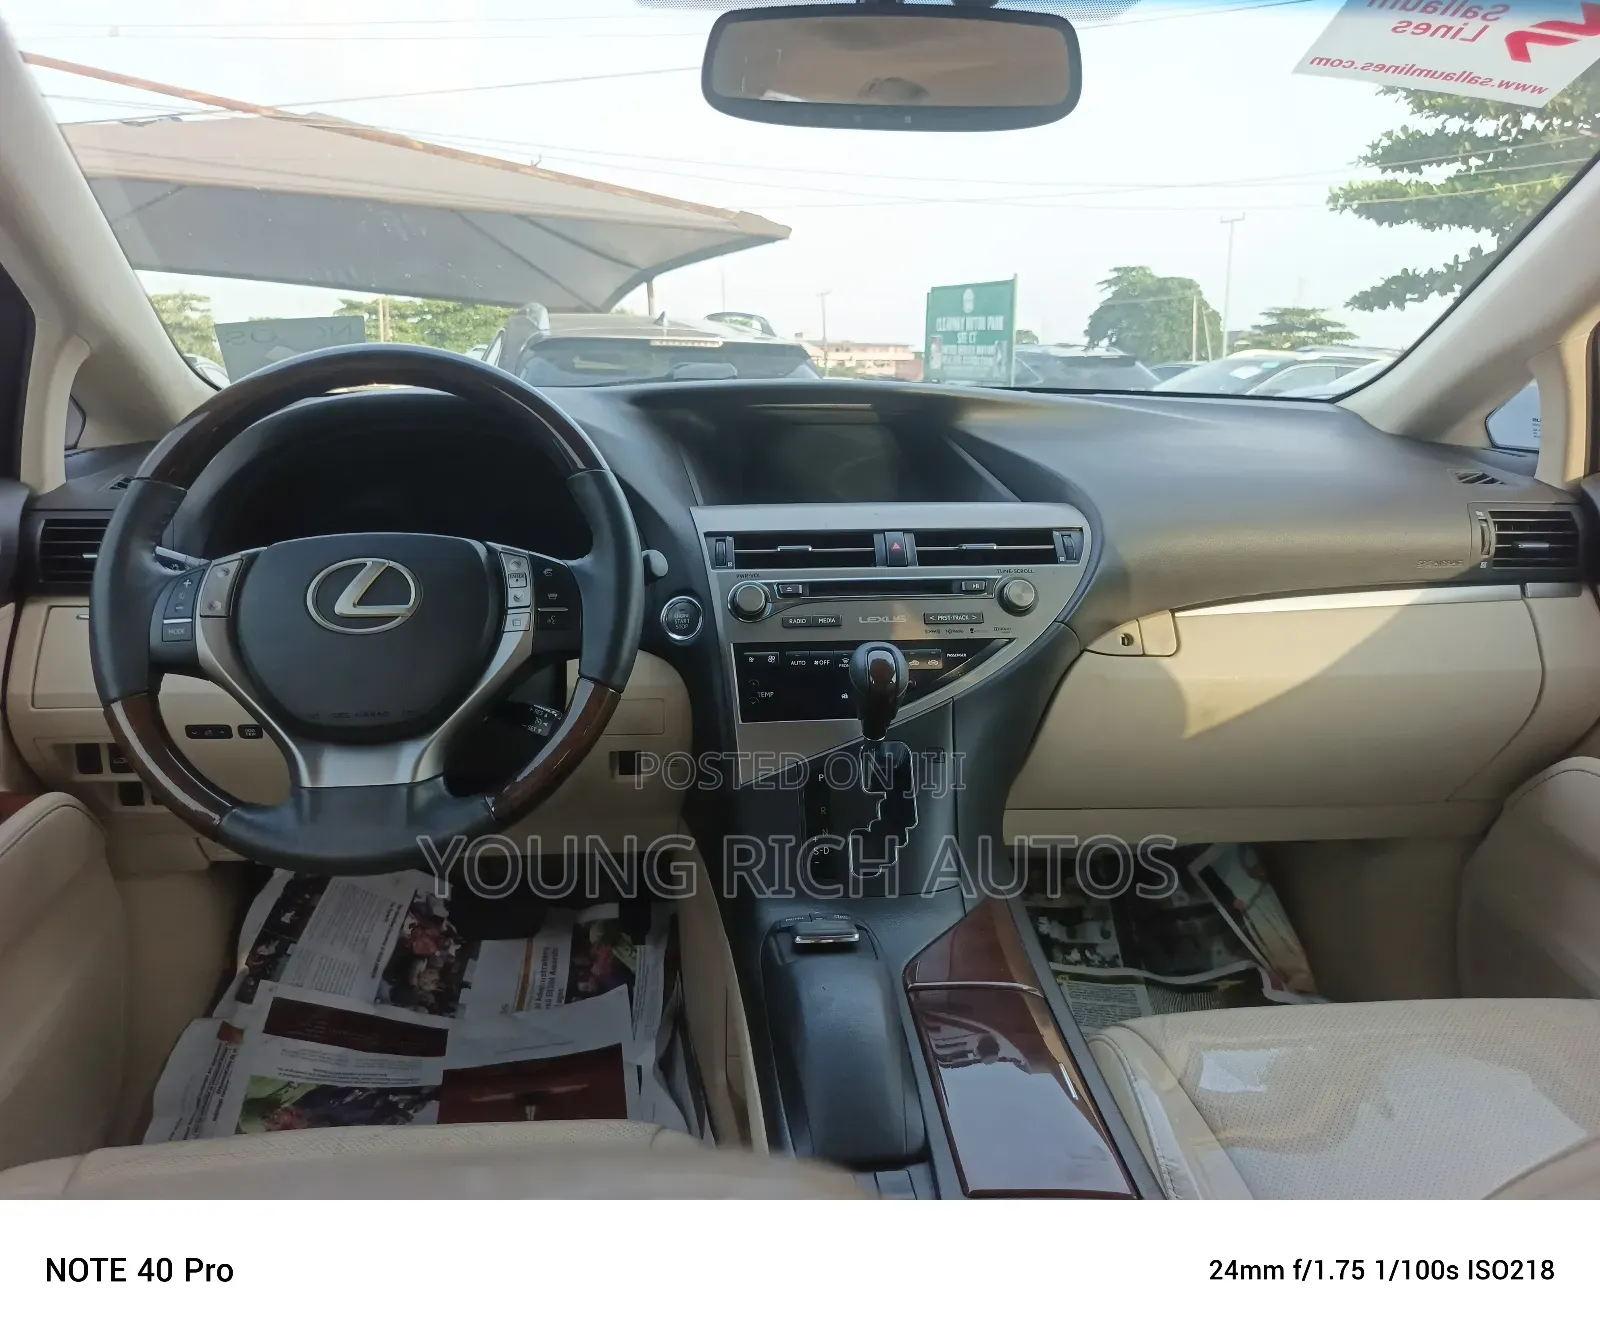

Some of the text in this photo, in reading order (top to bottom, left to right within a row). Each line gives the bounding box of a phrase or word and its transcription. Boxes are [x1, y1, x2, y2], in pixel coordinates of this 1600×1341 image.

[527, 724, 537, 732] SET
[818, 773, 825, 781] P
[820, 806, 826, 814] R
[822, 828, 828, 836] N
